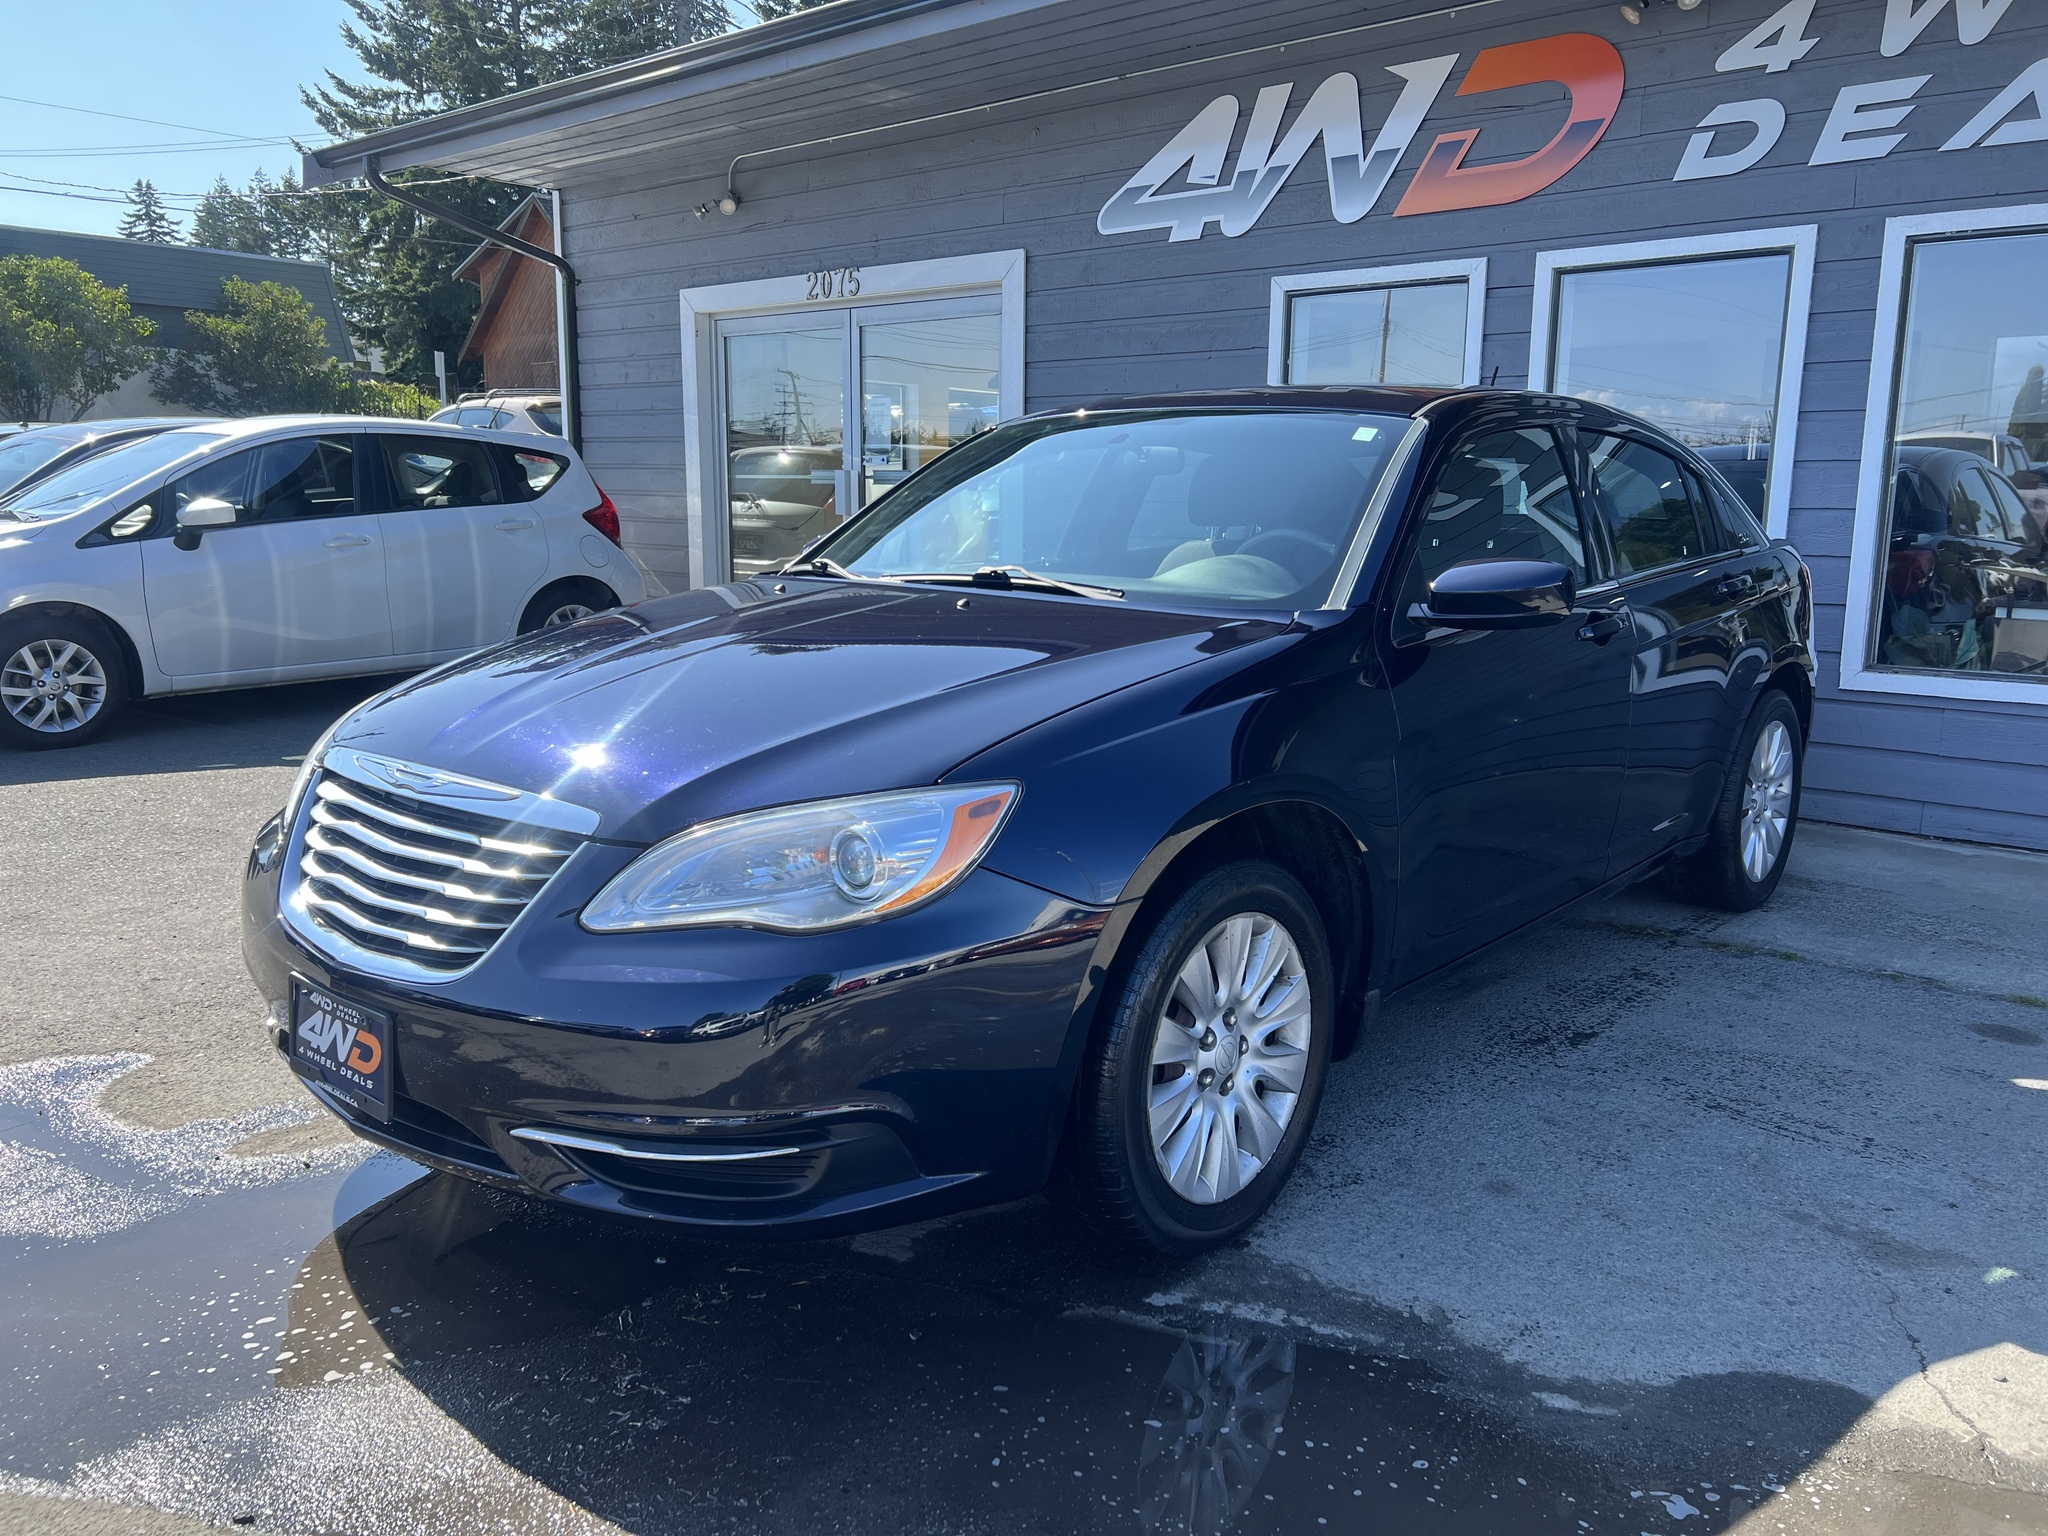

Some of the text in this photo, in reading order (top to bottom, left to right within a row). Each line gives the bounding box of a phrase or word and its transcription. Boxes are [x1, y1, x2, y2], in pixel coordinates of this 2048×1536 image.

[1097, 32, 1625, 242] 4WD
[806, 266, 860, 300] 2075
[310, 992, 333, 1012] 4WD
[336, 1010, 358, 1024] DEALS
[338, 1005, 360, 1018] WHEEL
[298, 1010, 382, 1075] 4WD
[299, 1046, 373, 1089] 4 WHEEL DEALS
